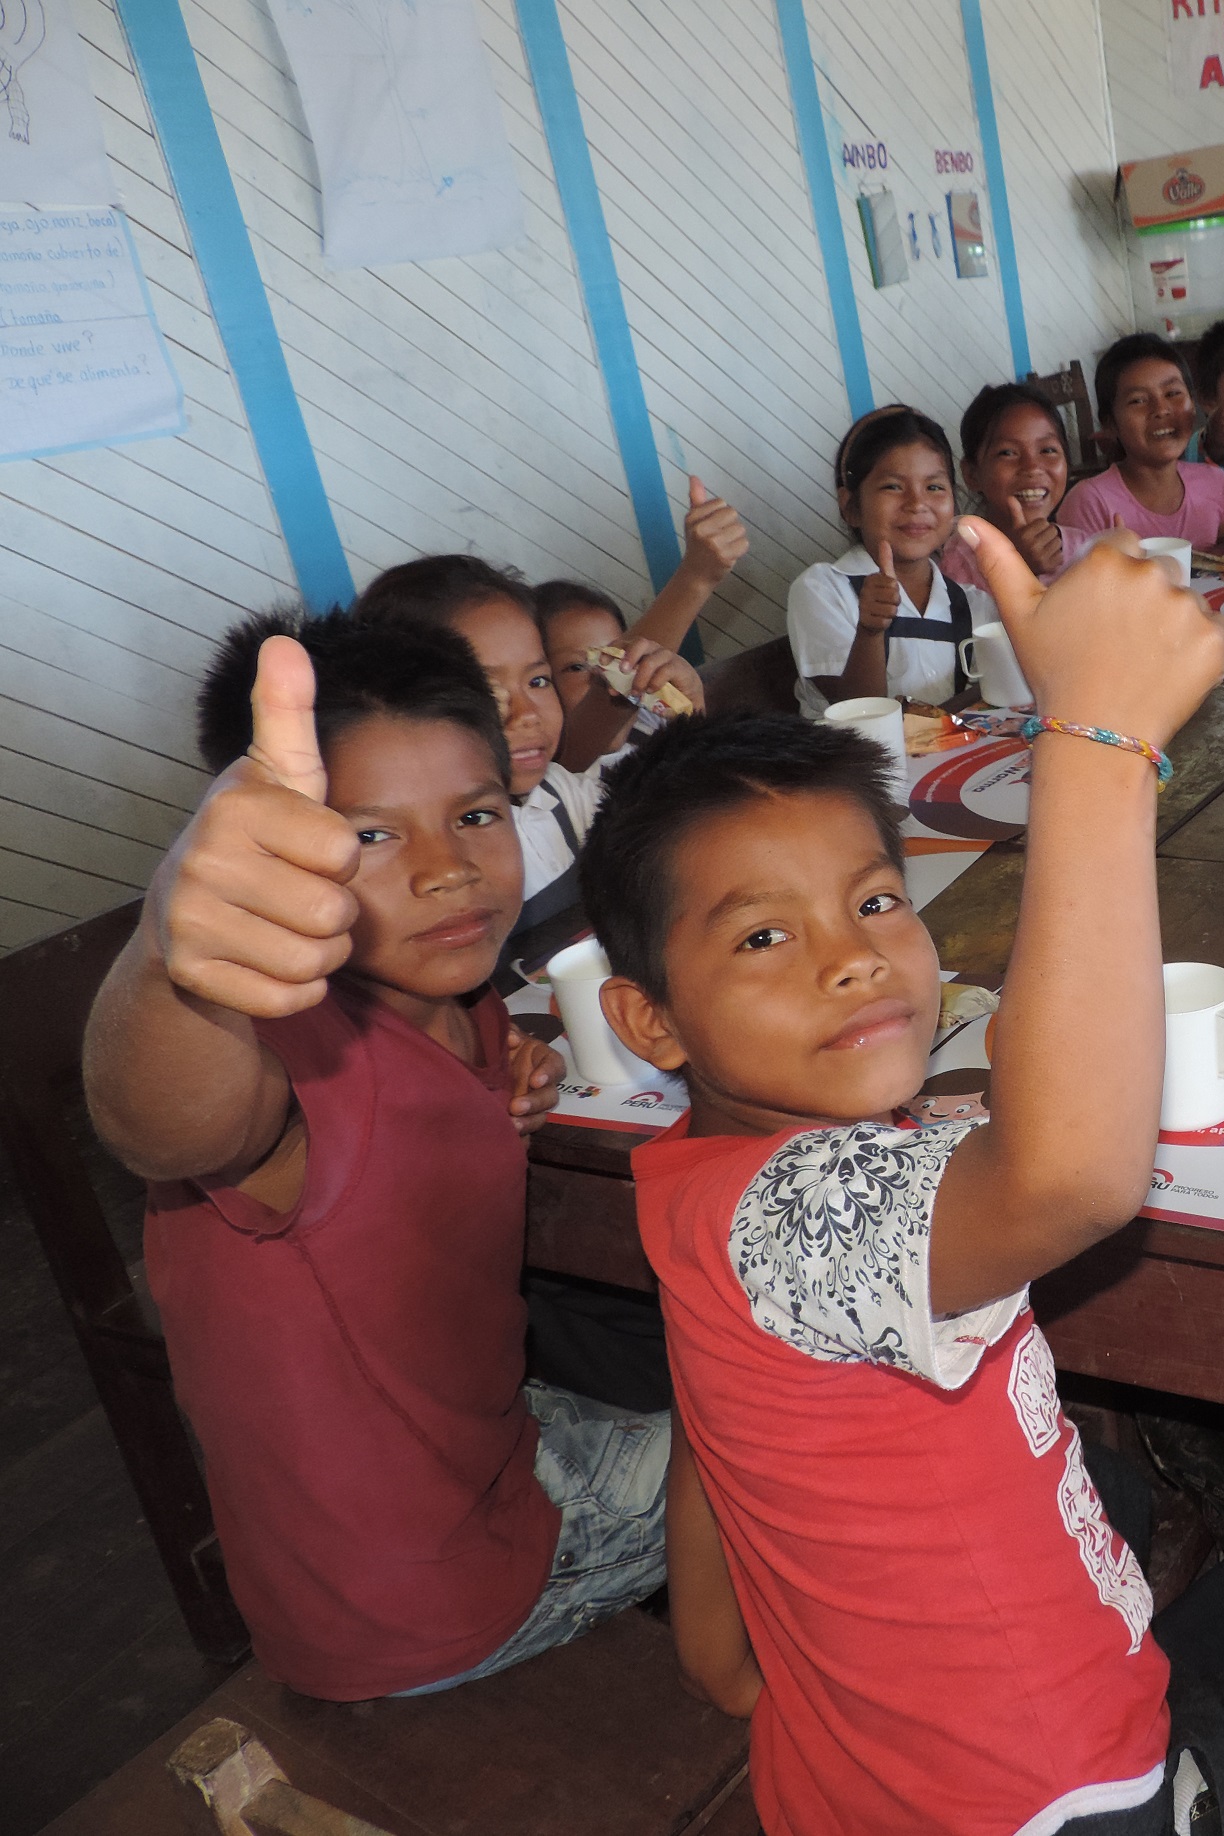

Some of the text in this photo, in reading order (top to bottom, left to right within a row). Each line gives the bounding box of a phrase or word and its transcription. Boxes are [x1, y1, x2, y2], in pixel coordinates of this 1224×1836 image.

[934, 149, 974, 174] BENBO
[619, 1099, 659, 1109] PERU
[1172, 1184, 1215, 1195] PROGRESO
